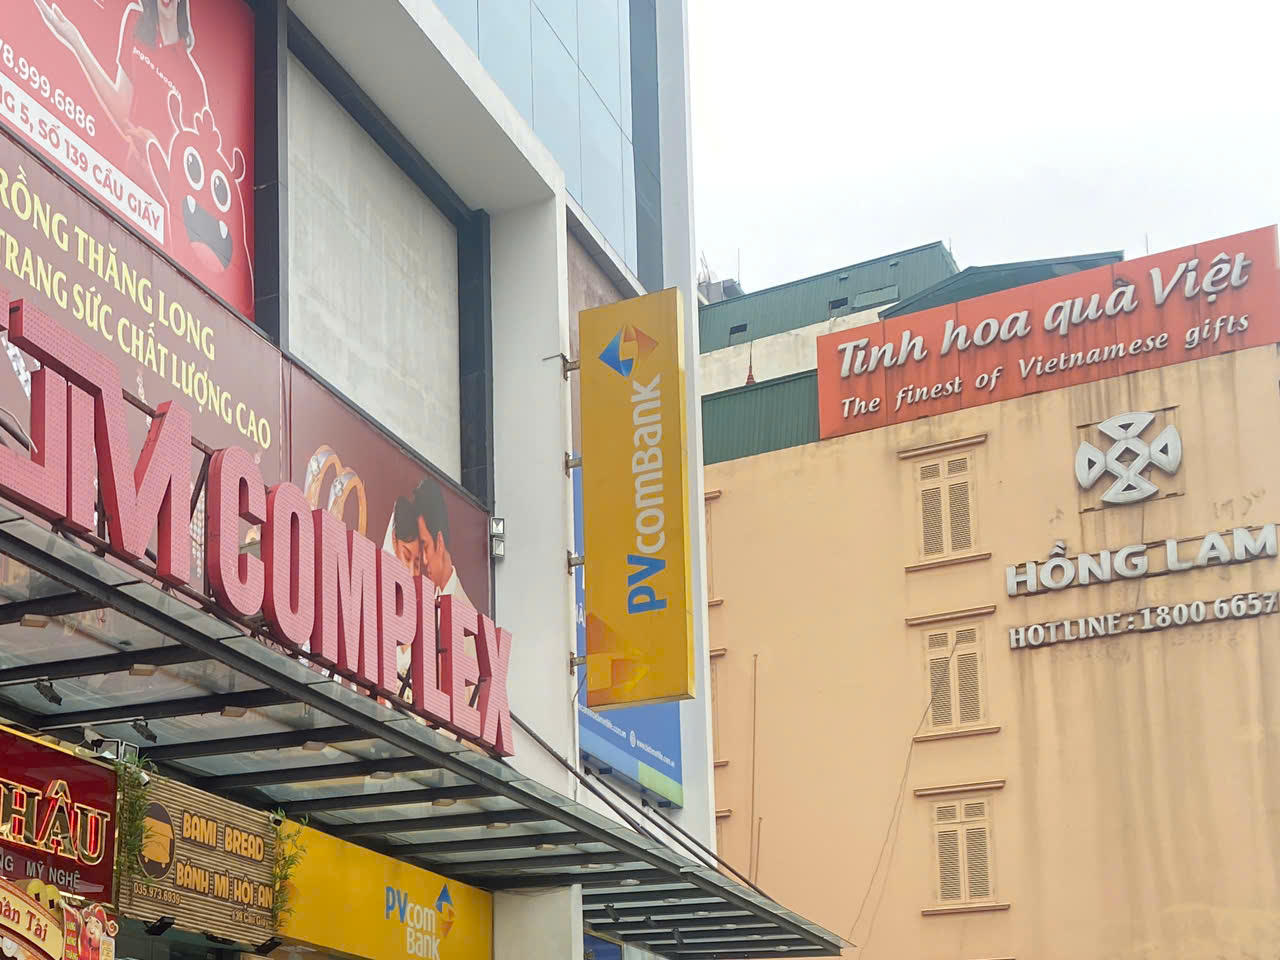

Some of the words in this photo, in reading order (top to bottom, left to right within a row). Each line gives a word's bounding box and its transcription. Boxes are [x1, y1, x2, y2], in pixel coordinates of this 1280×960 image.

[38, 119, 60, 149] SỐ
[64, 138, 89, 172] 139
[74, 225, 152, 320] THĂNG
[158, 290, 215, 360] LONG
[837, 329, 928, 379] Tinh
[940, 312, 1031, 357] hoa
[1043, 279, 1139, 337] quà
[1149, 251, 1253, 309] Việt
[72, 285, 113, 341] SỨC
[118, 317, 167, 379] CHẤT
[171, 353, 232, 425] LƯỢNG
[235, 402, 271, 450] CAO
[841, 396, 881, 419] The
[895, 376, 963, 412] finest
[975, 365, 1004, 394] of
[1018, 332, 1169, 380] Vietnamese
[1185, 315, 1250, 349] gifts
[627, 373, 668, 616] PVcomBank
[207, 446, 514, 757] COMPLEX
[1006, 540, 1148, 597] HỒNG
[1165, 523, 1279, 572] LAM
[26, 860, 45, 879] MỸ
[182, 811, 218, 848] BAMI
[224, 824, 265, 861] BREAD
[25, 910, 49, 942] Tài
[175, 858, 210, 894] BÁNH
[213, 870, 229, 900] MÌ
[233, 875, 254, 908] HỘI
[258, 884, 273, 909] AN
